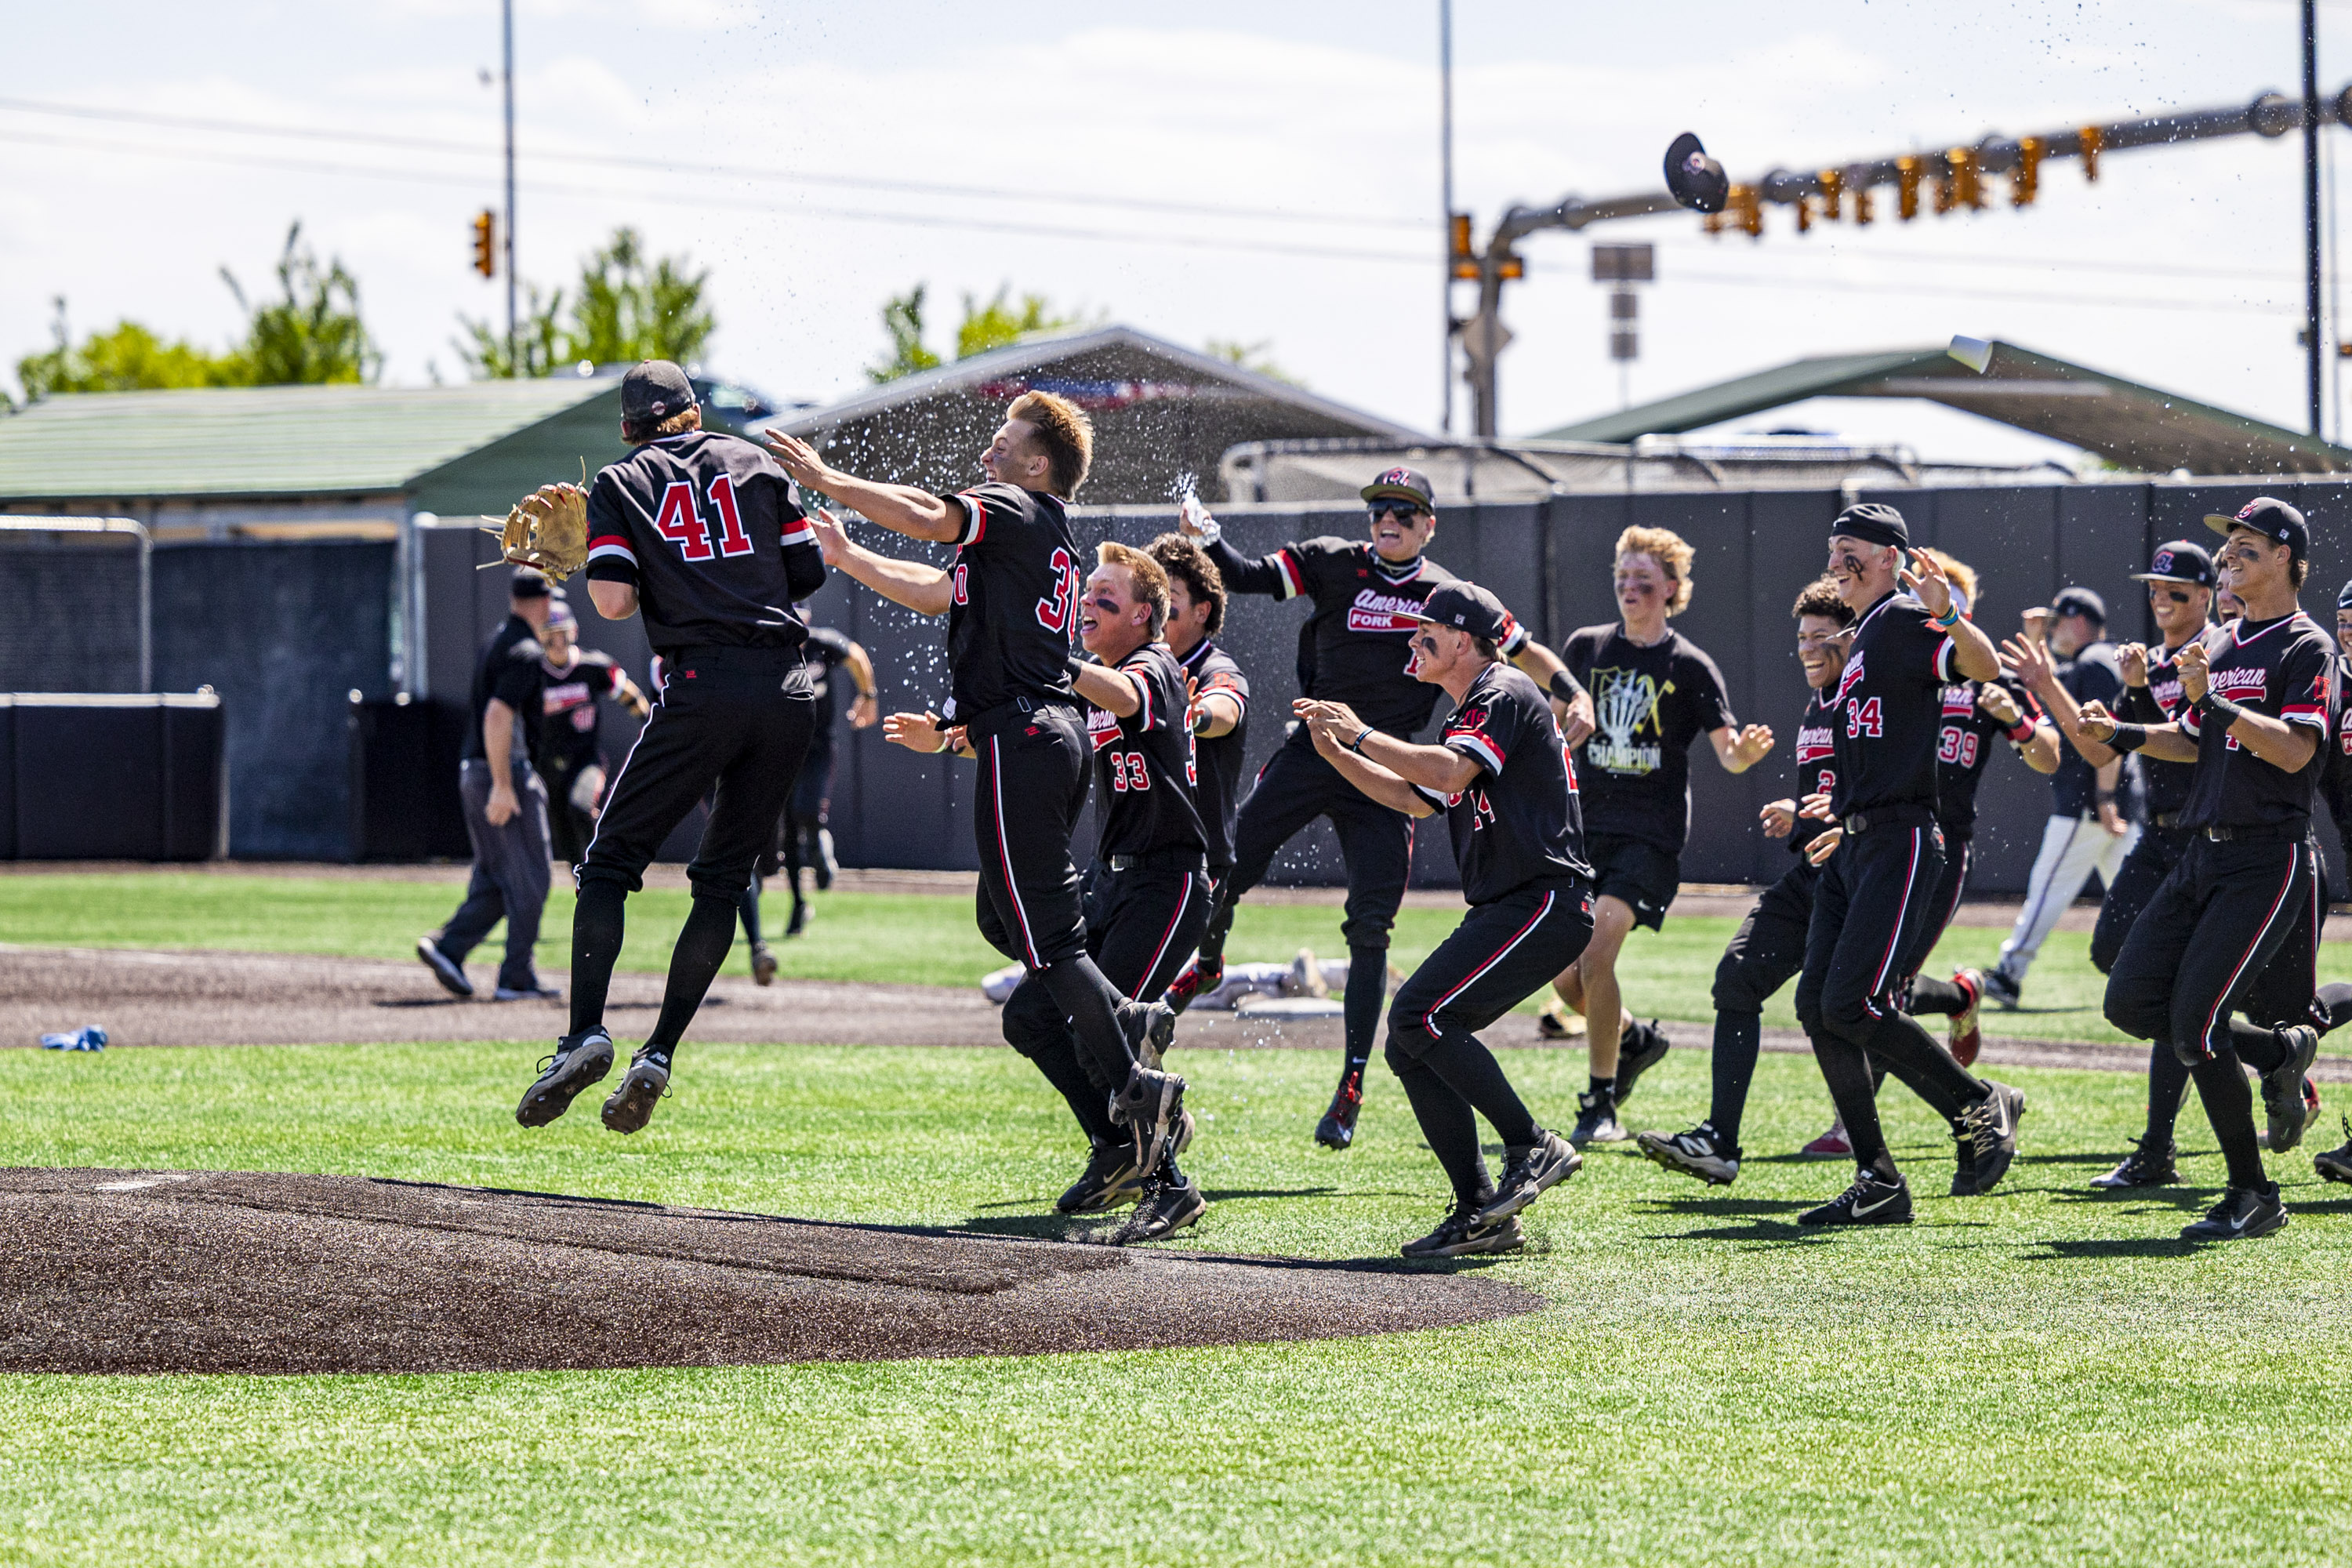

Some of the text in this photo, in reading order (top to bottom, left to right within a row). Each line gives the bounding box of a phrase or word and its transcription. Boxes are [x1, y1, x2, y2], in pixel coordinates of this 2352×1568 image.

[654, 473, 754, 561] 41
[1352, 614, 1393, 627] FORK
[1846, 697, 1883, 739] 34
[1938, 726, 1979, 768] 39
[1110, 752, 1151, 792] 33
